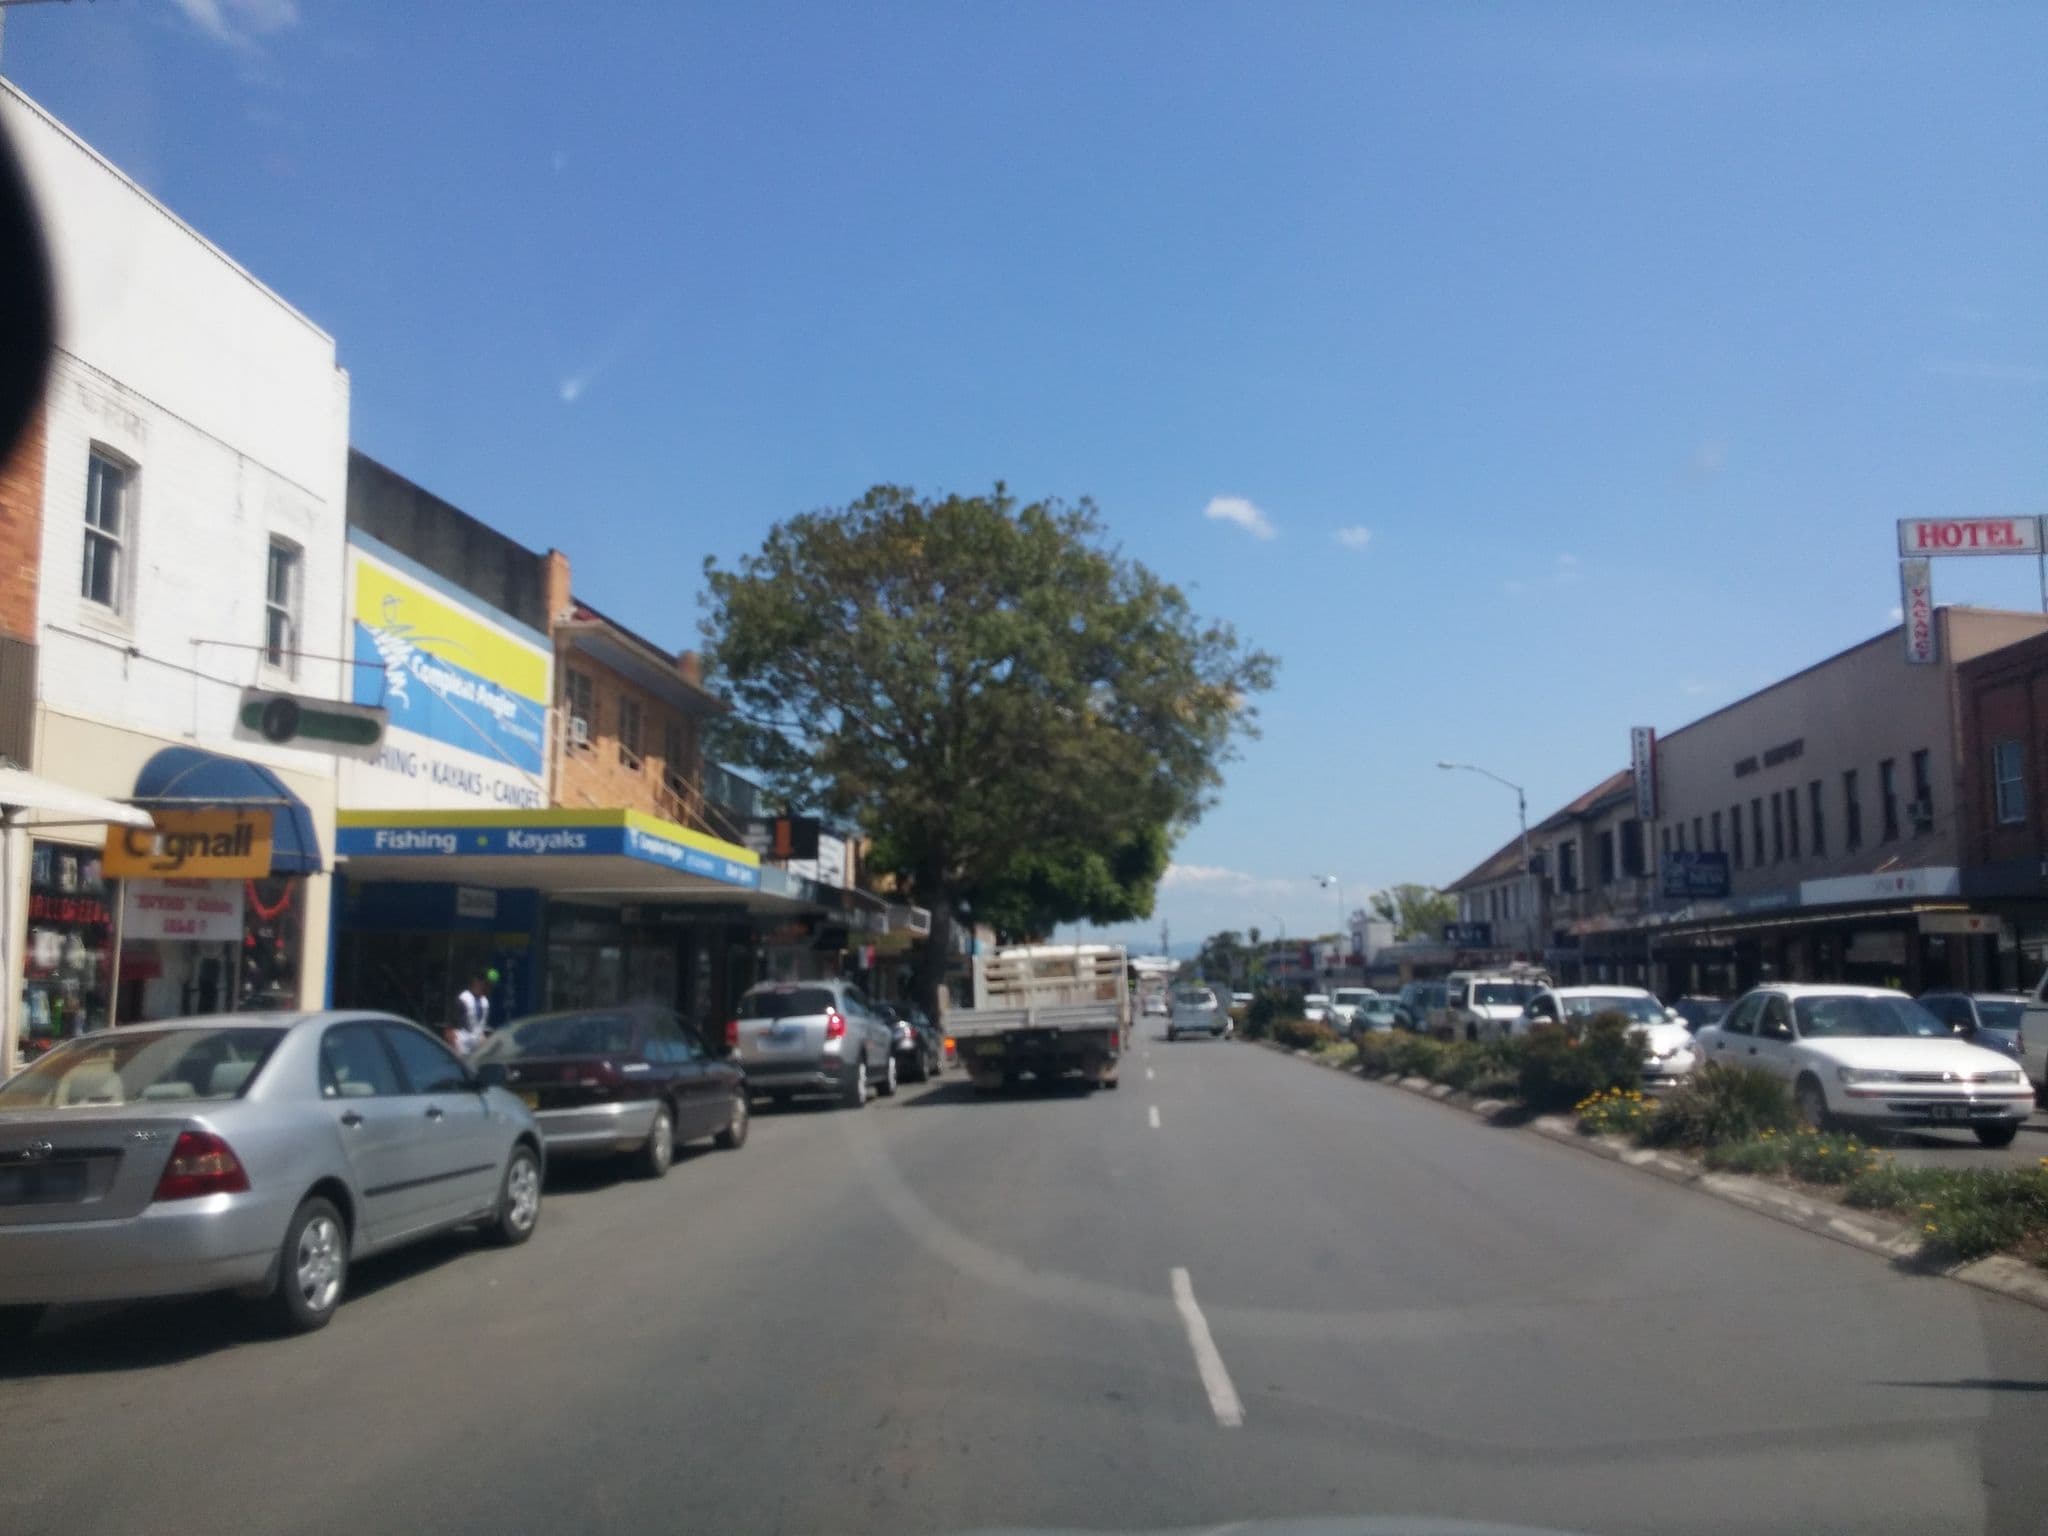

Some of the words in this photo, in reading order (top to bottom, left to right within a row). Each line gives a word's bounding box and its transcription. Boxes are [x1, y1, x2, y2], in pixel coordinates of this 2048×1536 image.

[1916, 522, 2023, 547] HOTEL
[1911, 588, 1930, 660] VACANCY
[370, 747, 417, 777] HING
[431, 760, 482, 795] KAYAKS
[375, 831, 458, 854] Fishing
[507, 831, 586, 854] Kayaks
